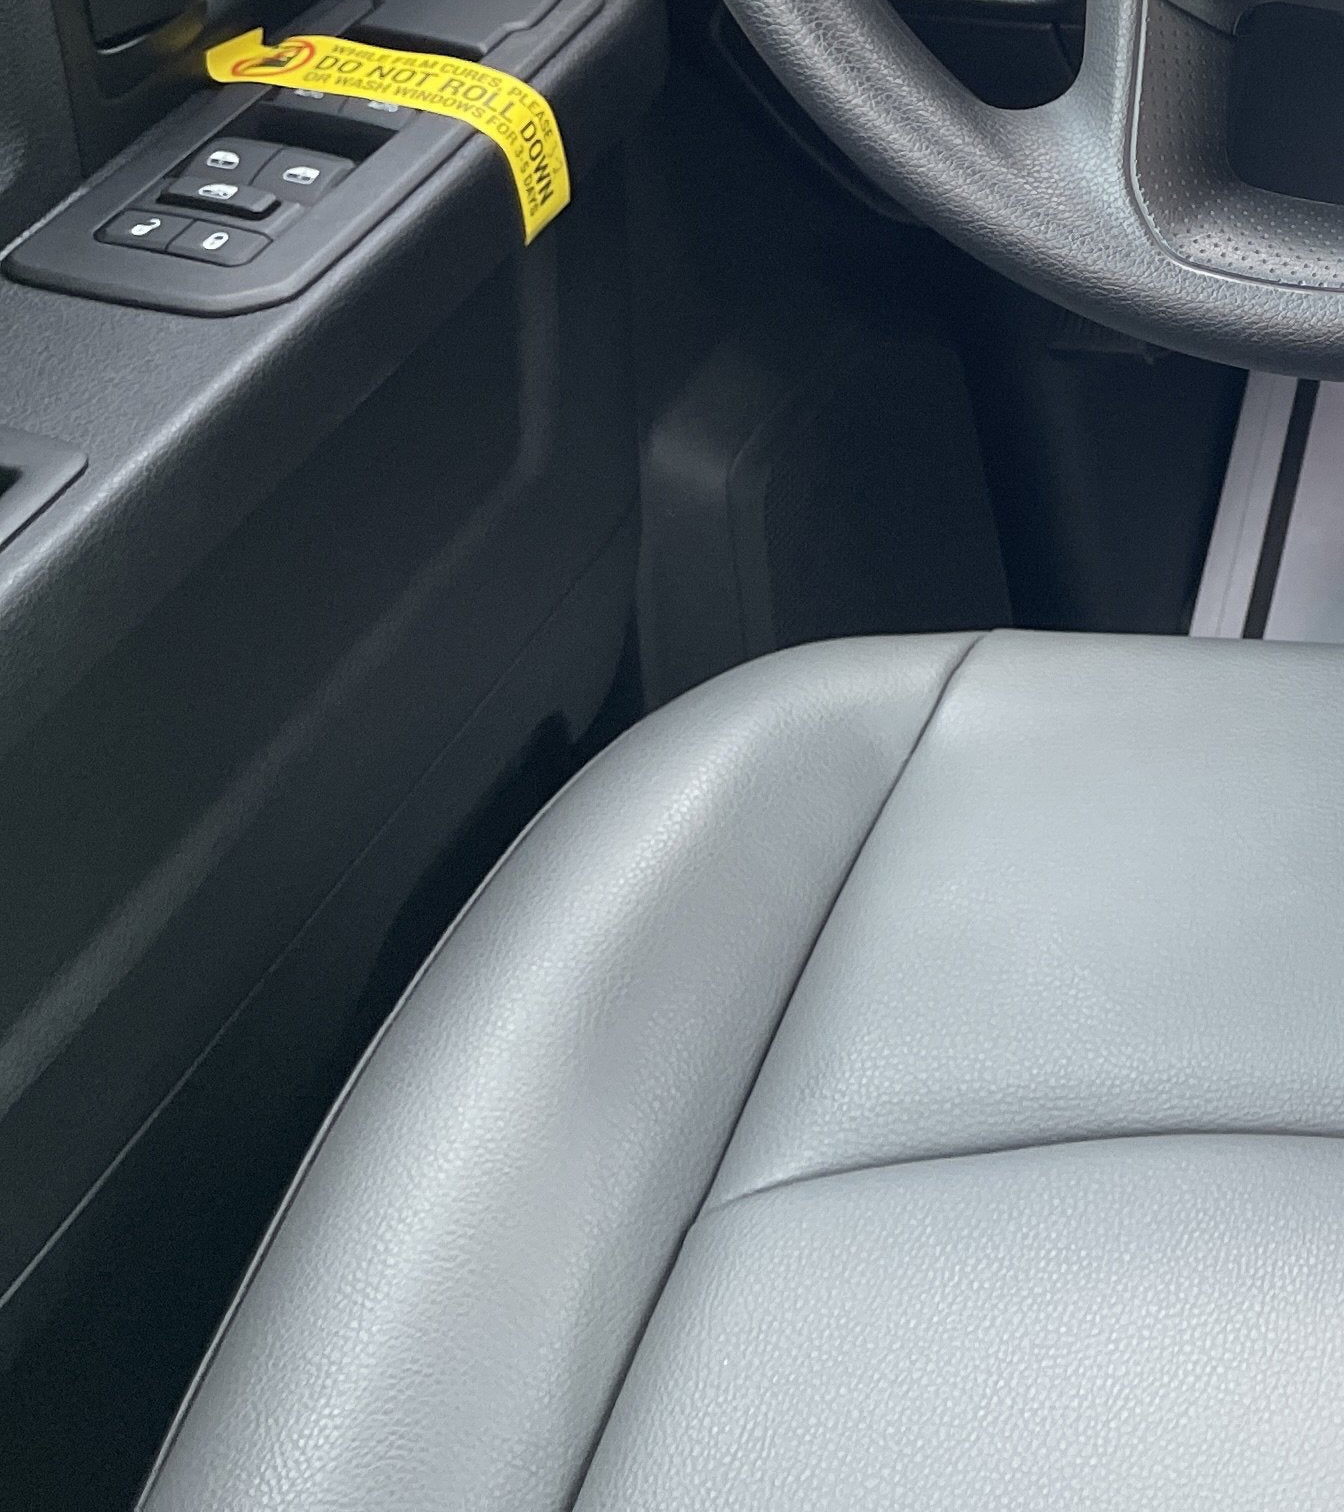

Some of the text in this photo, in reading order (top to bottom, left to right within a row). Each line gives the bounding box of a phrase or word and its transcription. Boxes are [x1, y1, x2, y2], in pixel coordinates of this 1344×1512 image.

[314, 55, 554, 207] DO NOT ROLL DOWN
[332, 45, 391, 63] WHILE
[507, 86, 554, 139] PLEASE
[334, 77, 392, 94] WASH
[394, 87, 487, 119] WINDOWS
[486, 115, 519, 147] FOR
